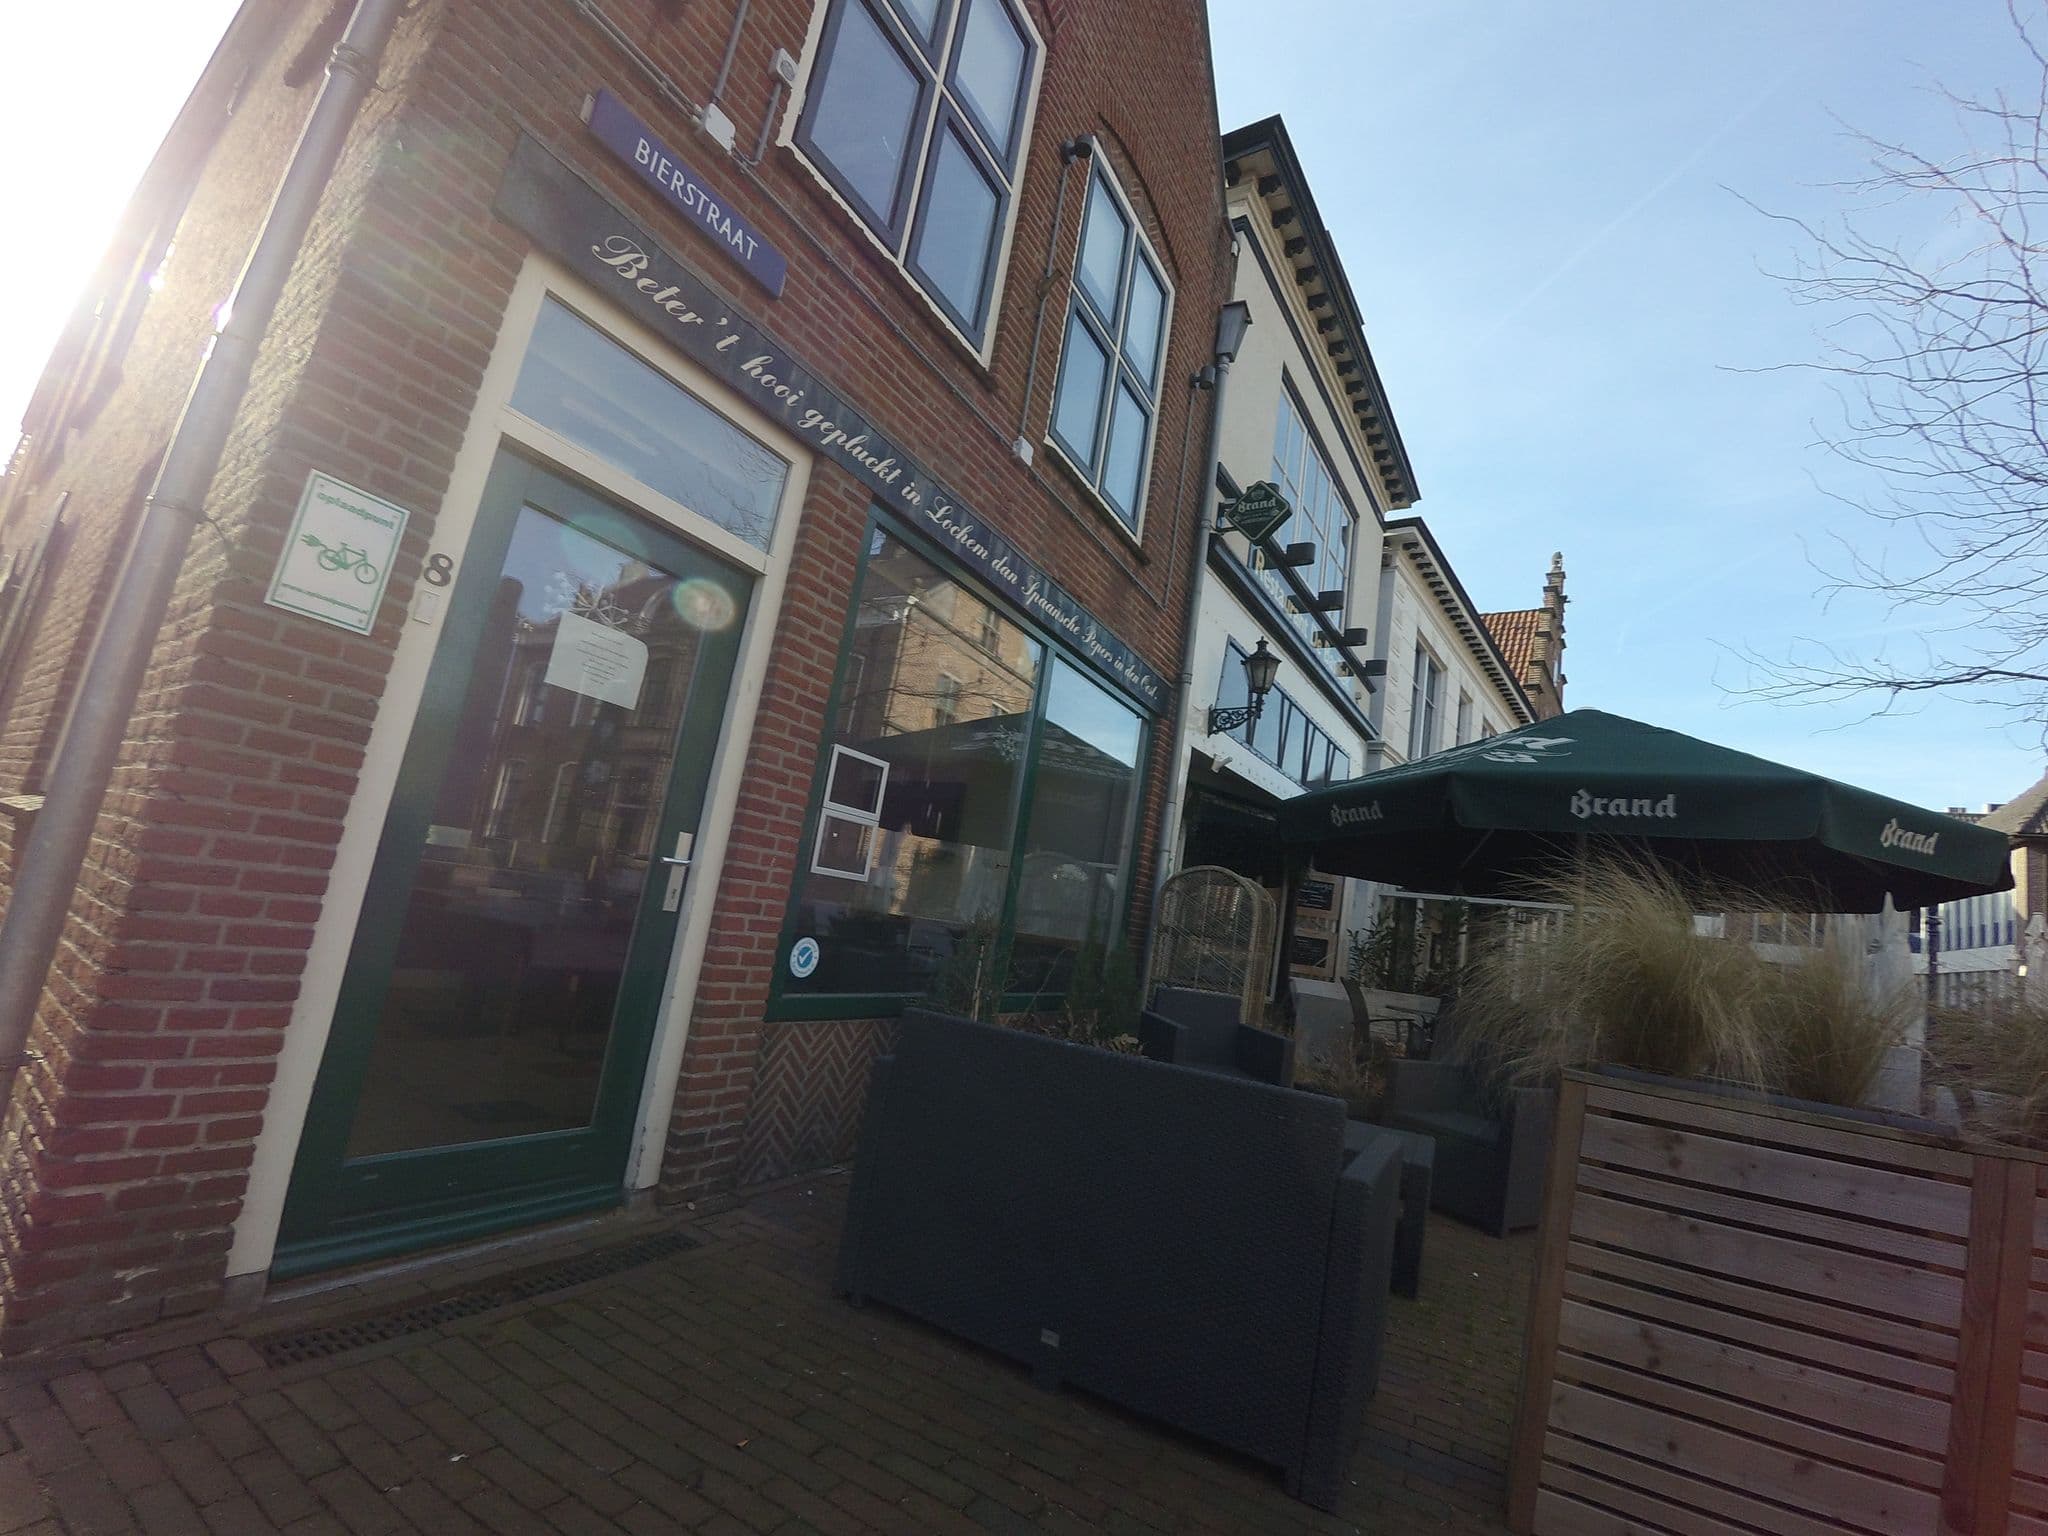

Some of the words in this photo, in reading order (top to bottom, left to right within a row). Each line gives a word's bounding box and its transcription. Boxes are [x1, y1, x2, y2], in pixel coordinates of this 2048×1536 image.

[634, 137, 758, 260] BIERSTRAAT
[592, 236, 704, 325] Beter
[716, 317, 740, 351] 't
[740, 356, 804, 407] hooi
[797, 409, 902, 485] gepluckt
[901, 481, 921, 506] in
[925, 495, 989, 560] Lochem
[991, 556, 1019, 585] dan
[1021, 575, 1081, 636] Spaansche
[1113, 656, 1125, 672] in
[1237, 496, 1277, 513] Brand
[423, 553, 454, 587] 8
[1330, 799, 1384, 827] Brand
[1570, 788, 1678, 819] Brand
[1880, 817, 1940, 855] Brand
